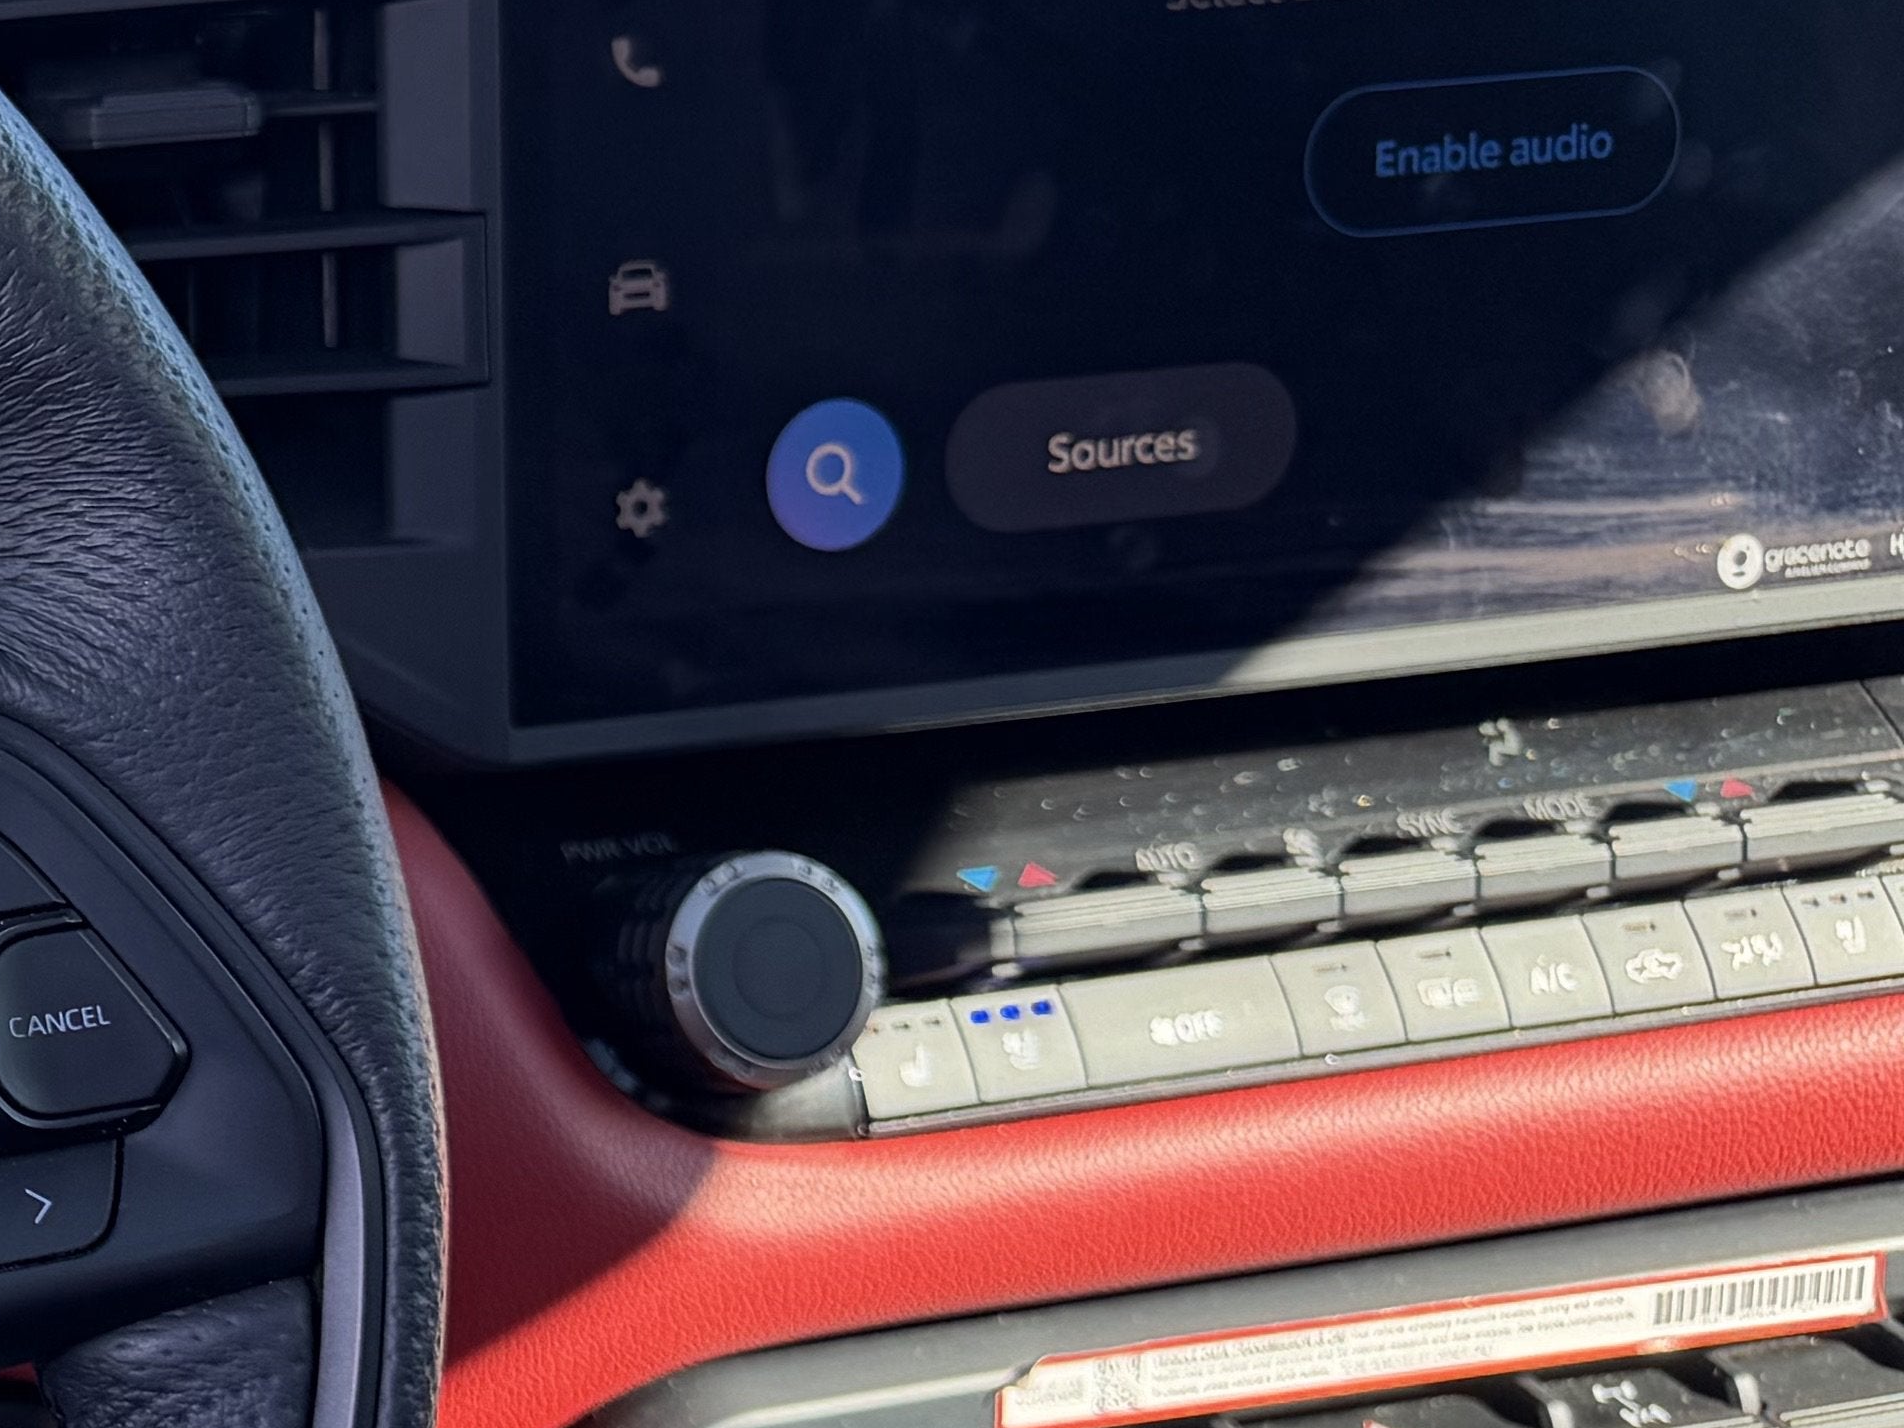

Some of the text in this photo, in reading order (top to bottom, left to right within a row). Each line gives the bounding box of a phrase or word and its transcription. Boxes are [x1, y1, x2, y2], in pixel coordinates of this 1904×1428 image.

[1373, 123, 1615, 178] Enable audio
[1047, 429, 1200, 474] Sources
[1396, 808, 1465, 839] SYNC
[1522, 792, 1601, 822] MODE
[7, 1003, 111, 1040] CANCEL
